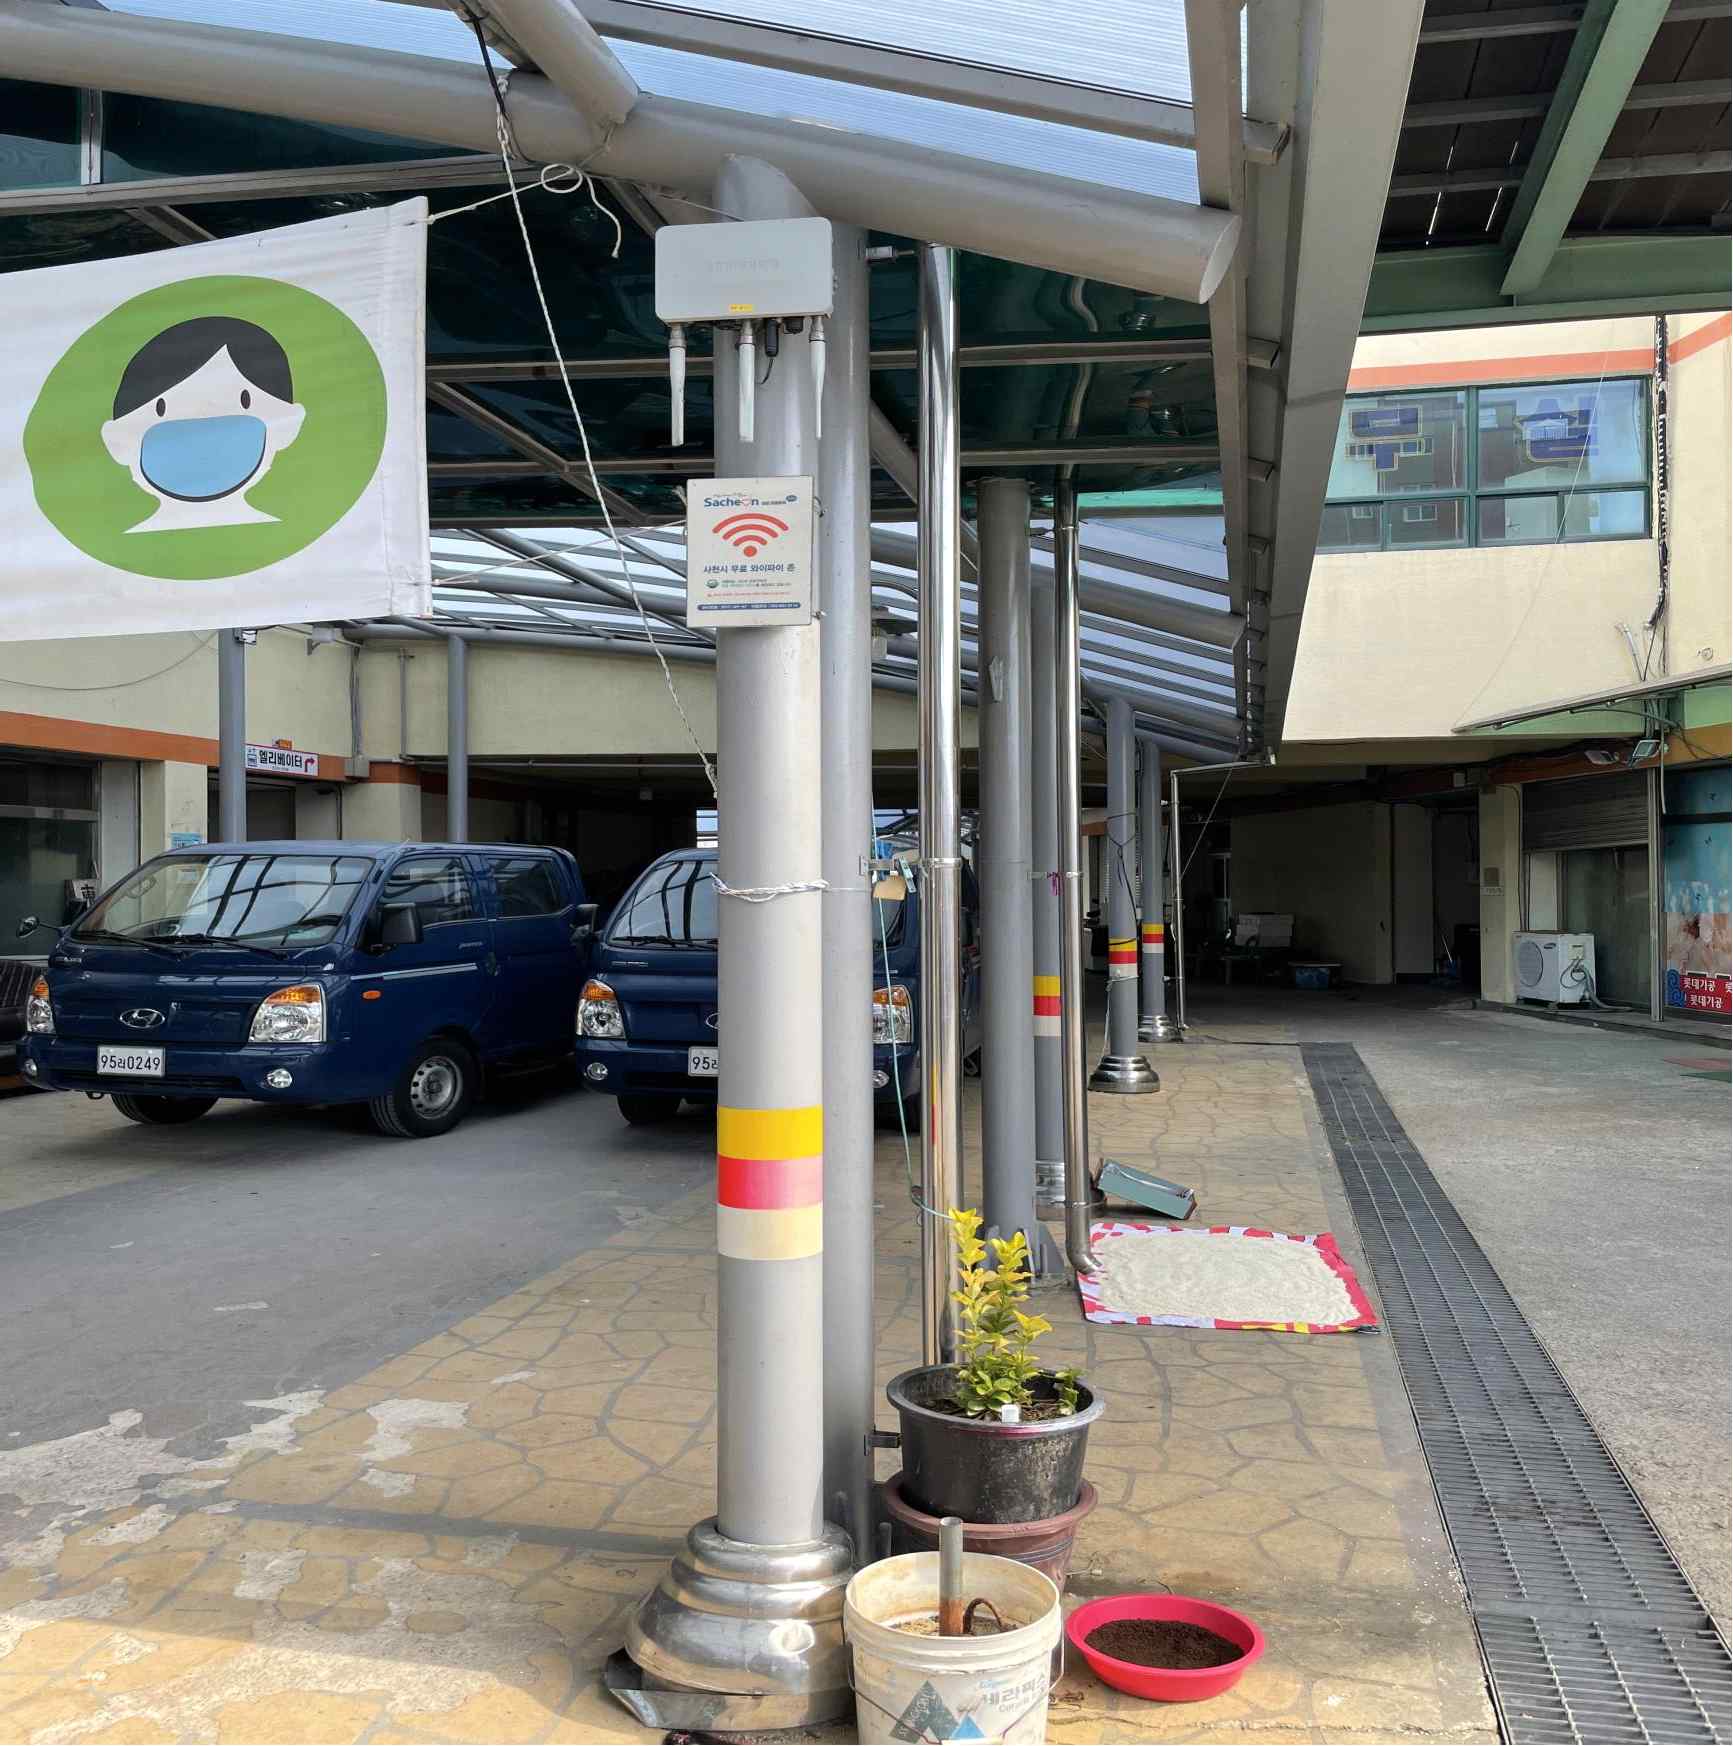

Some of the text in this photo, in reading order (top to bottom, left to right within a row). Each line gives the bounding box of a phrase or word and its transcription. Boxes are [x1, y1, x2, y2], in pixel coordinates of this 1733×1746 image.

[704, 562, 797, 574] 사천시 무료 와이파이 존
[260, 751, 302, 769] 엘리베이터
